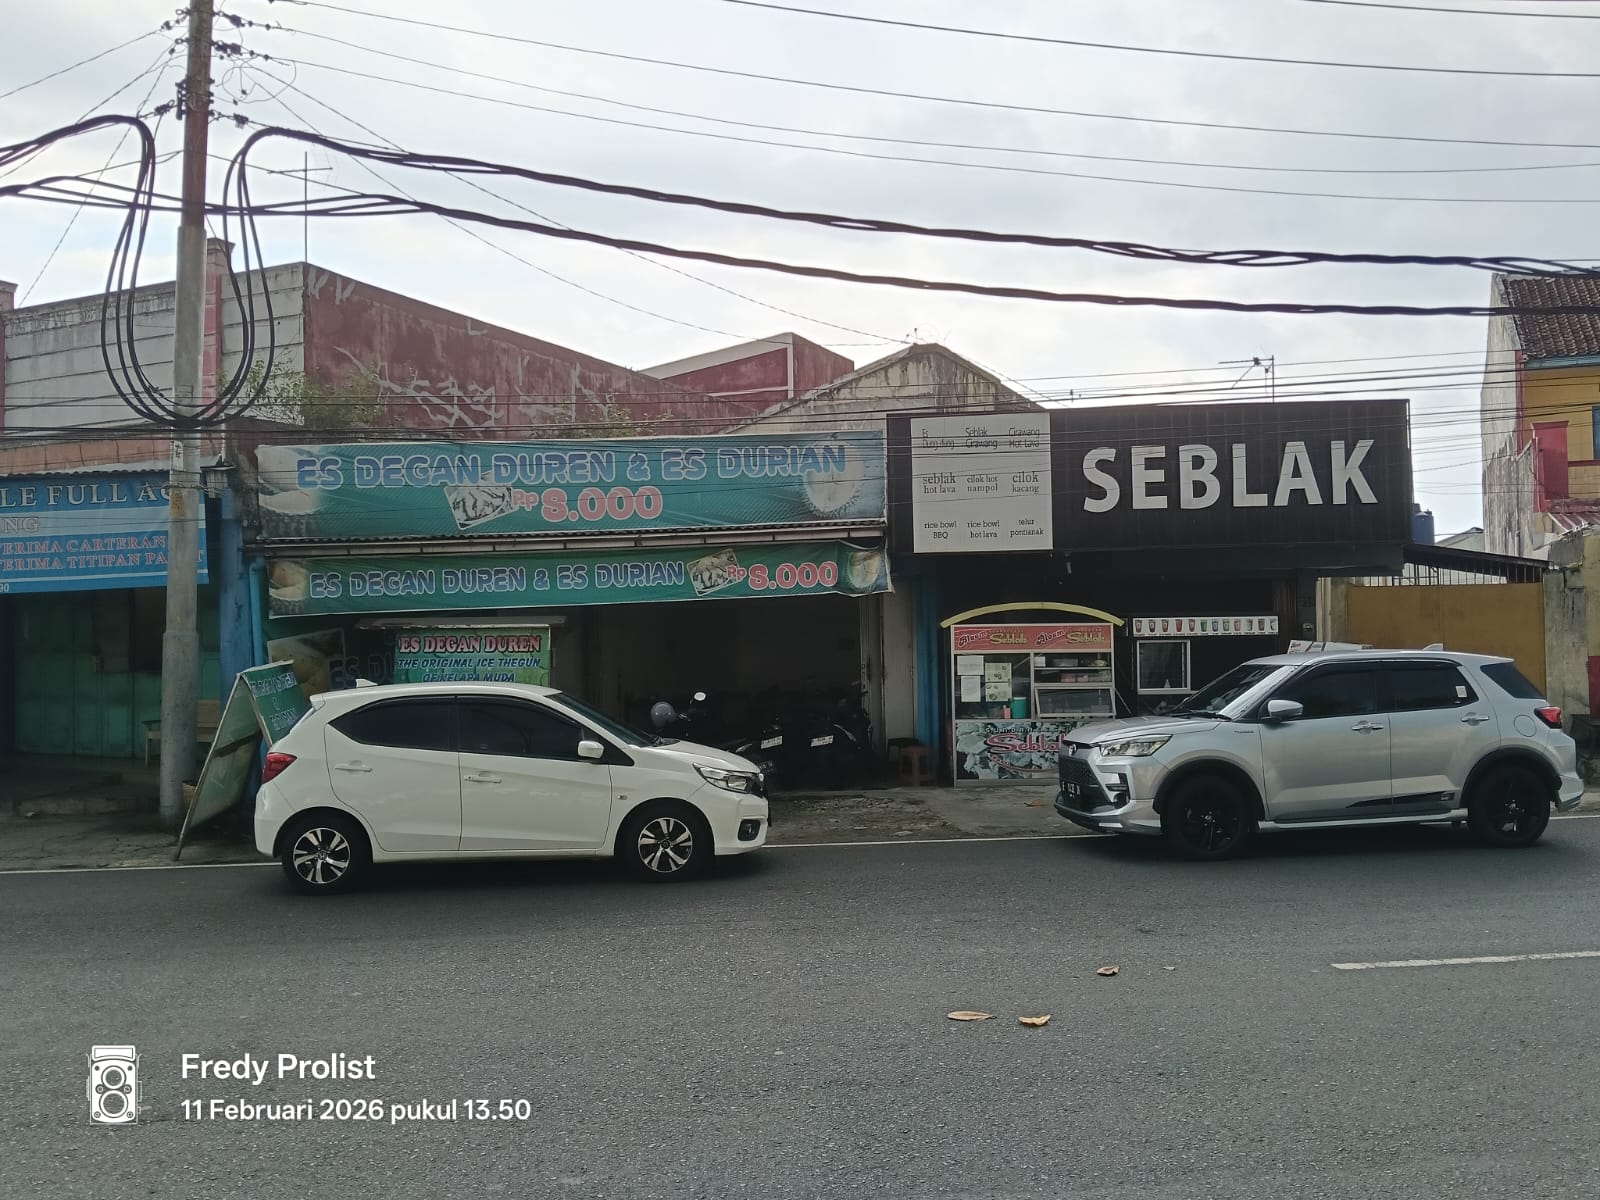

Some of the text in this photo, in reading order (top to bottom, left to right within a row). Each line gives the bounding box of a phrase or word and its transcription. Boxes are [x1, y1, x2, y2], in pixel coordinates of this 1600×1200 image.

[295, 445, 847, 490] ES DEGAN DUREN & ES DURIAN
[923, 472, 956, 485] seblak
[1012, 470, 1039, 483] cilok
[1082, 439, 1378, 513] SEBLAK
[47, 483, 128, 505] FULL
[923, 485, 956, 494] hot lava
[967, 484, 998, 493] nampol
[1012, 485, 1039, 495] kacang
[511, 486, 664, 523] Rp 8.000
[0, 516, 40, 533] NG
[983, 520, 1000, 528] bowl
[1018, 518, 1034, 526] telur
[933, 531, 949, 539] BBQ
[983, 530, 998, 538] lava
[66, 536, 167, 552] CARTERAN
[67, 552, 141, 569] TITIPAN
[145, 549, 204, 567] PAT
[309, 561, 685, 598] ES DEGAN DUREN & ES DURIAN
[726, 560, 838, 590] Rp 8.000
[399, 635, 541, 653] ES DEGAN DUREN
[398, 658, 541, 668] THE ORIGINAL ICE THEGUN
[438, 672, 480, 682] KELAPA
[483, 672, 515, 682] MUDA
